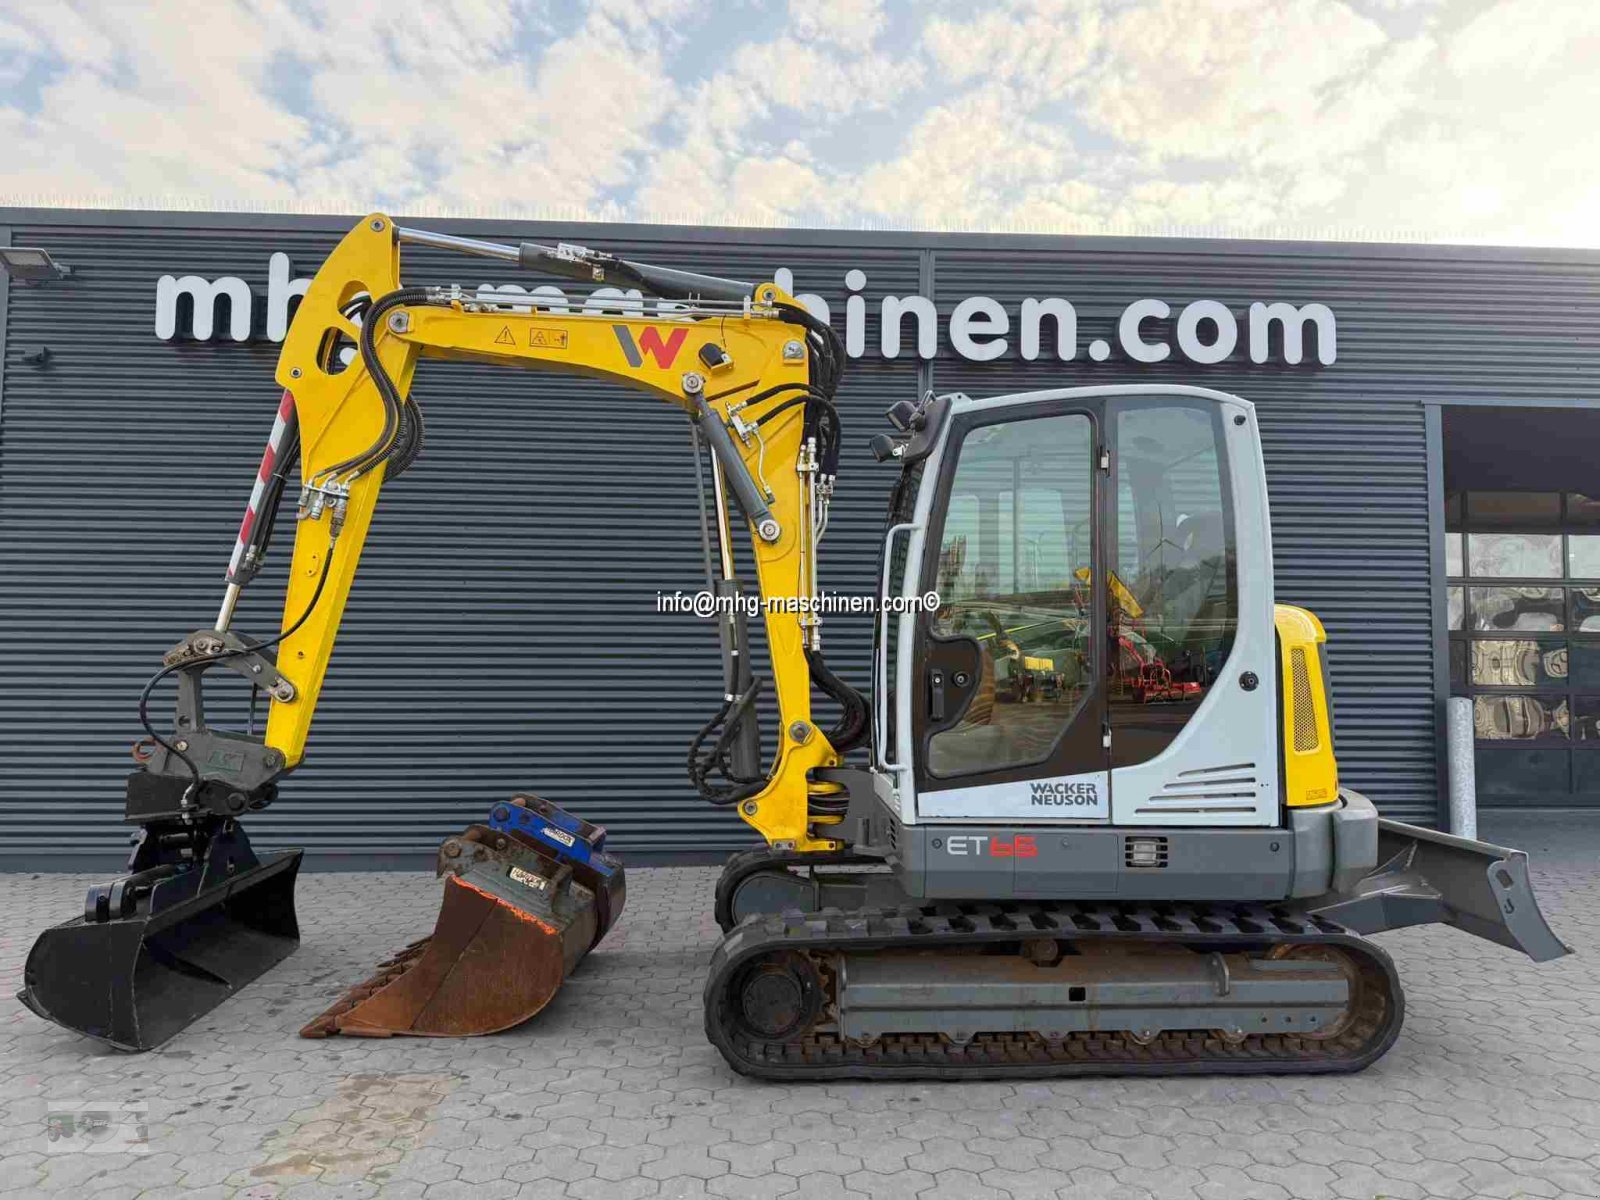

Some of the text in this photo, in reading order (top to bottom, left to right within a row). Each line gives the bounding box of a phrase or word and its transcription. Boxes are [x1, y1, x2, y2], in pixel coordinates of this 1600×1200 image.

[1030, 782, 1097, 795] WACKER
[1031, 794, 1098, 806] NEUSON
[946, 835, 1038, 857] ET65
